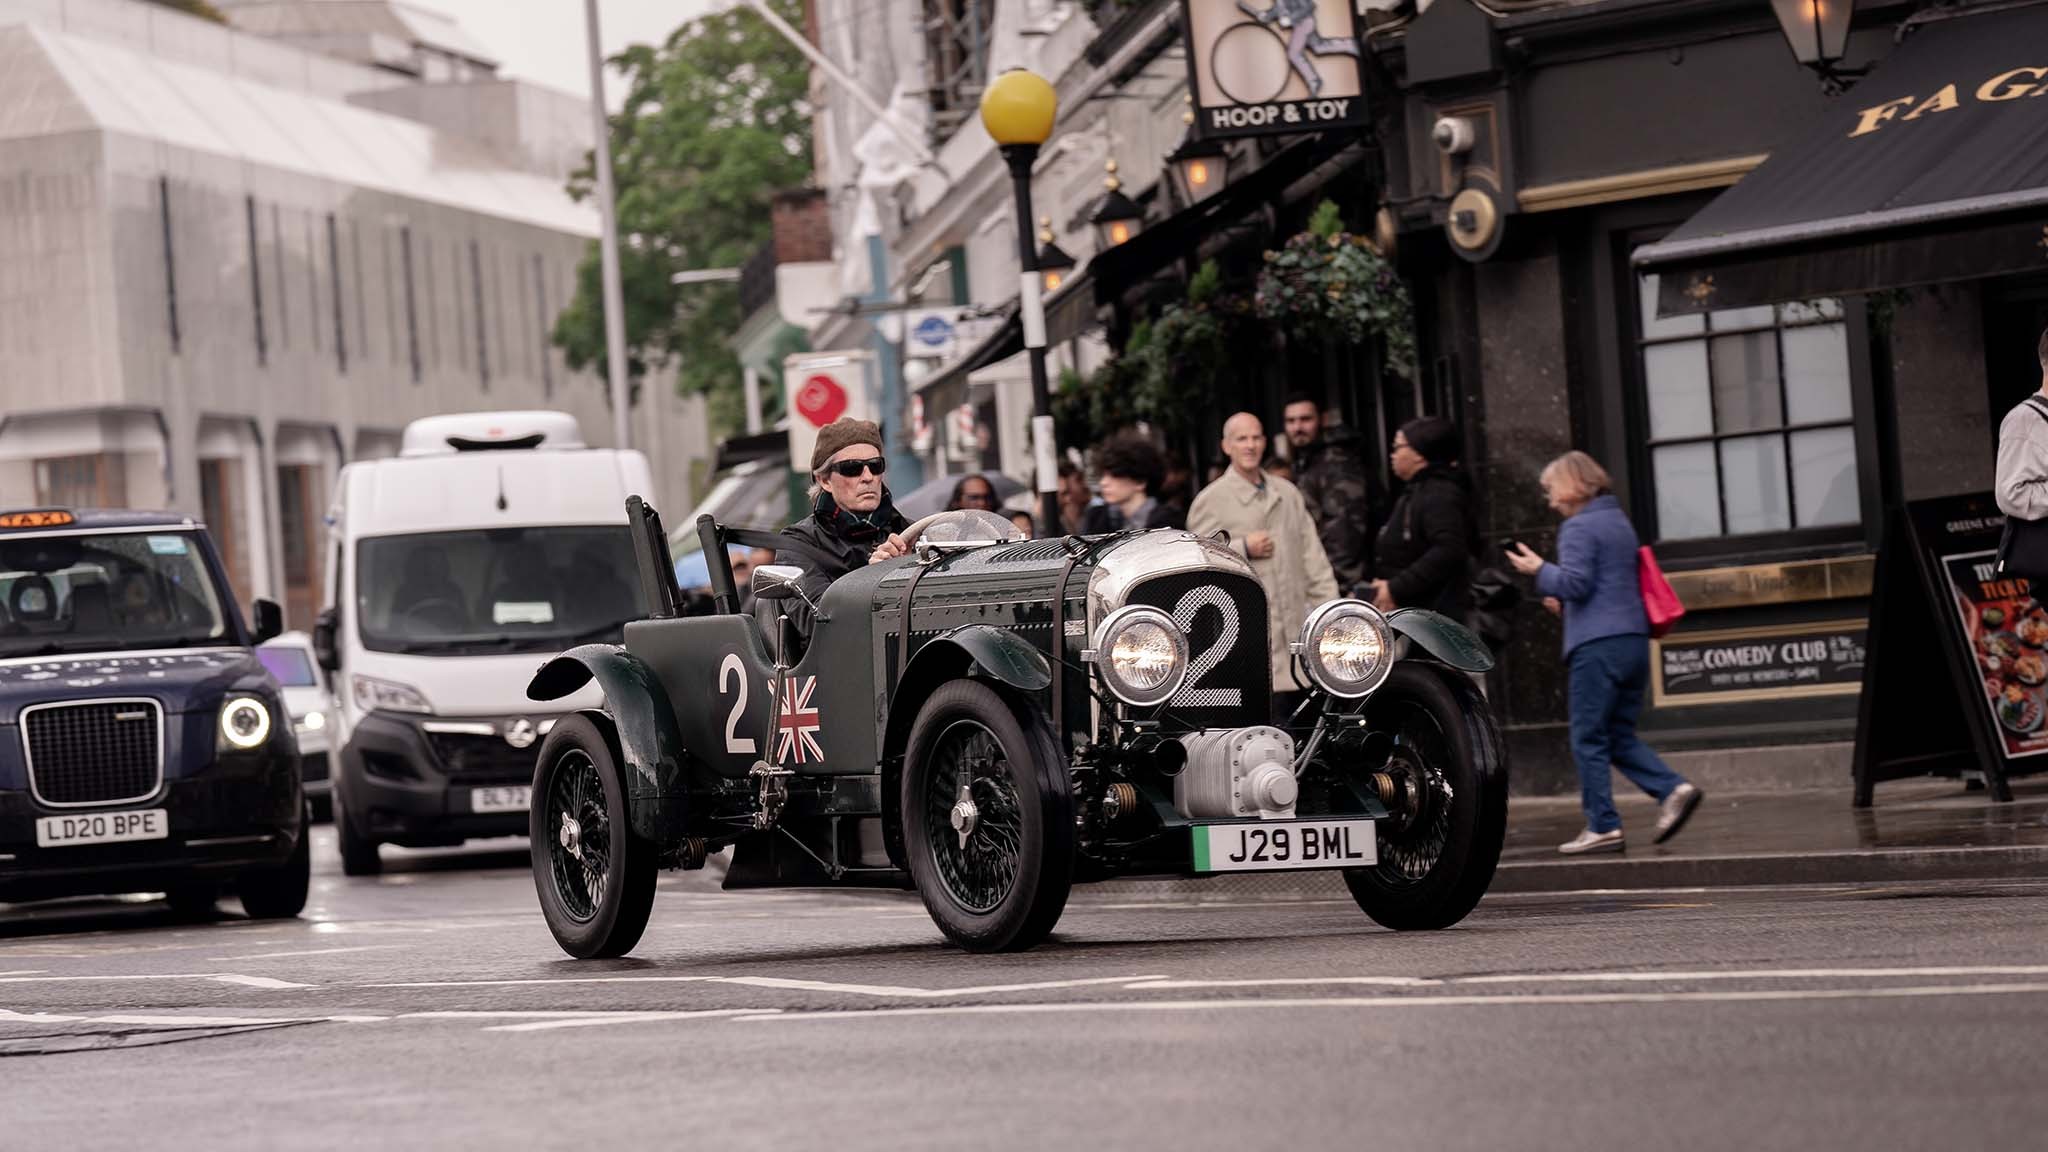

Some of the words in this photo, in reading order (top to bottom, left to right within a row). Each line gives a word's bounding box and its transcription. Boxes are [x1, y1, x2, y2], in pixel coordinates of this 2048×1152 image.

[1212, 105, 1279, 128] HOOP
[1283, 103, 1301, 123] &
[1303, 99, 1349, 121] TOY
[7, 511, 65, 527] TAXI
[1170, 584, 1242, 707] 2
[1704, 645, 1776, 669] COMEDY
[1781, 640, 1828, 664] CLUB
[719, 653, 757, 754] 2
[47, 817, 106, 840] LD20
[113, 813, 156, 835] BPE
[1229, 828, 1290, 863] J29
[1301, 826, 1363, 861] BML
